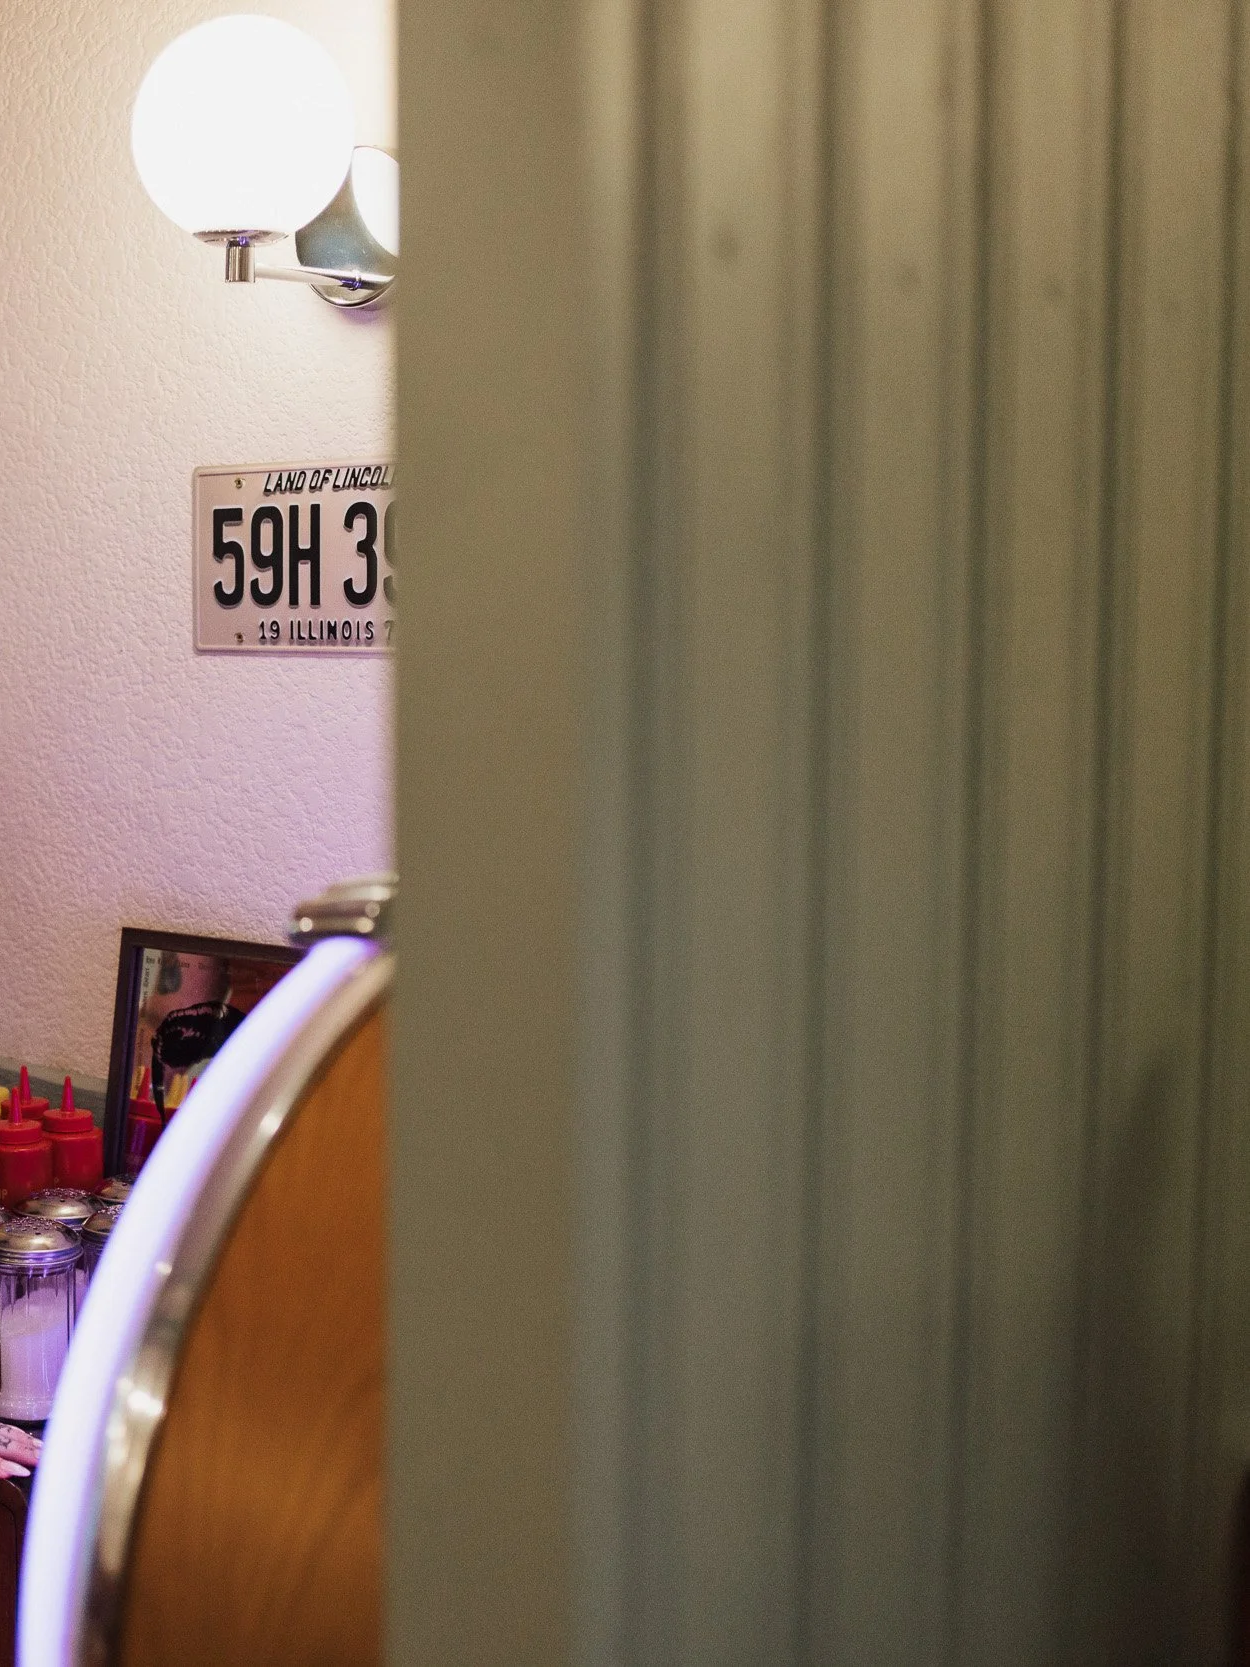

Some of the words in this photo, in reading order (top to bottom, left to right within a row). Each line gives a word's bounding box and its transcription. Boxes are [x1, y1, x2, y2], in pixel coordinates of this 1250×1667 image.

[263, 471, 307, 493] LAND
[309, 469, 332, 490] OF
[212, 503, 321, 607] 59H
[258, 620, 281, 640] 19
[290, 620, 375, 641] ILLINOIS
